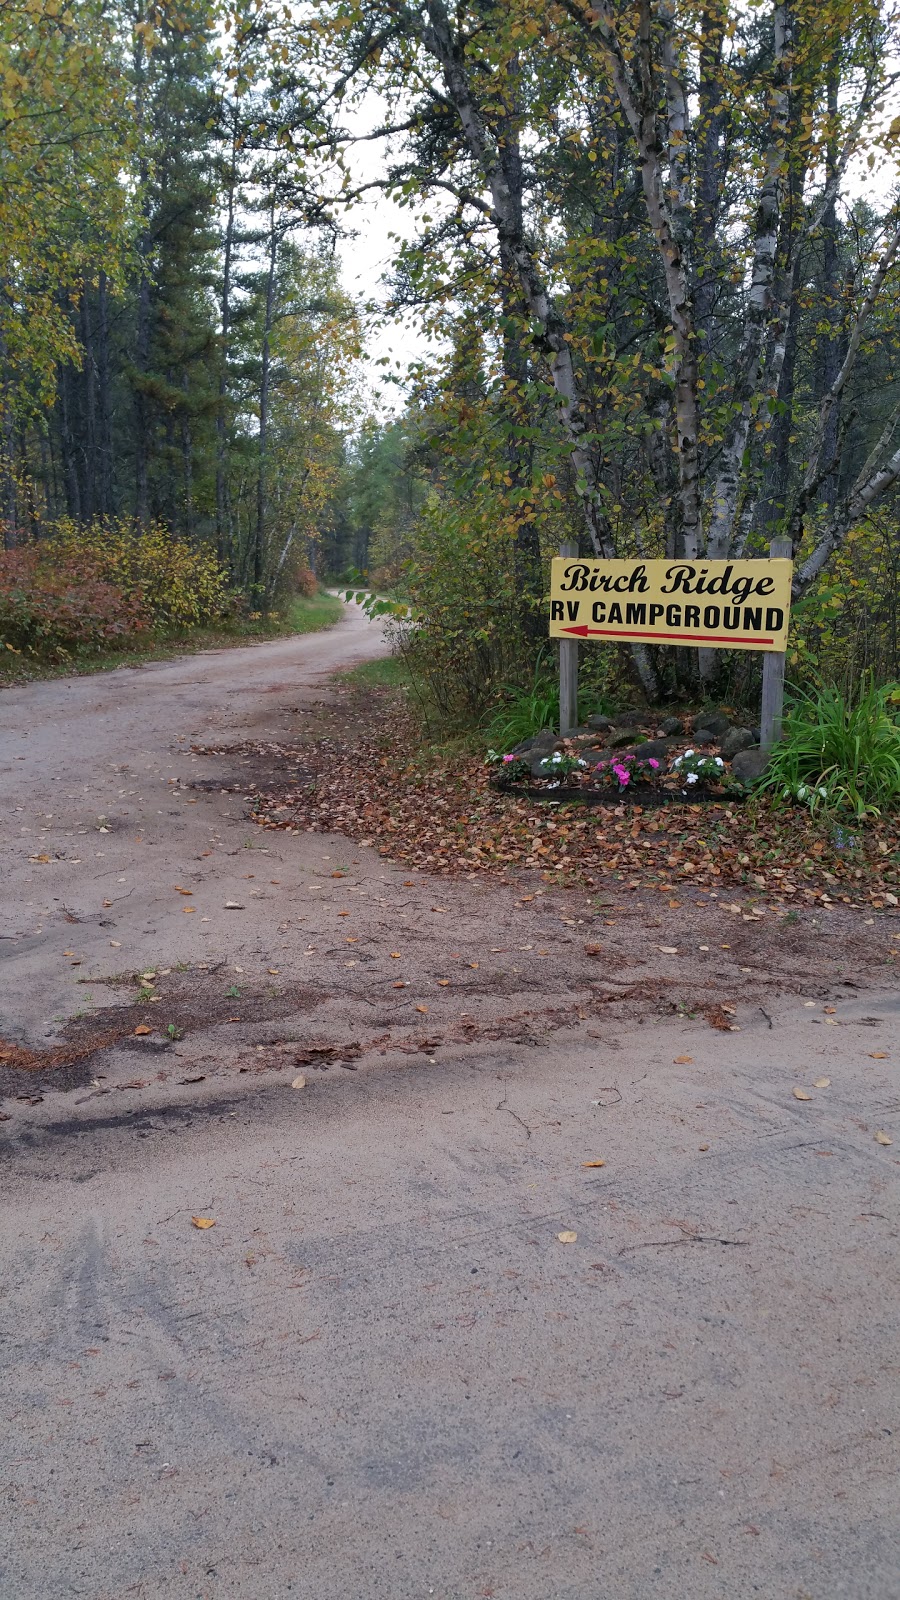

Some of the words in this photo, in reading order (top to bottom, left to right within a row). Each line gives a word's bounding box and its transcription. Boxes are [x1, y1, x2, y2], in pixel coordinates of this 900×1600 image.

[560, 564, 650, 592] Birch
[660, 565, 775, 604] Ridge
[551, 600, 580, 621] RV
[592, 601, 784, 631] CAMPGROUND
